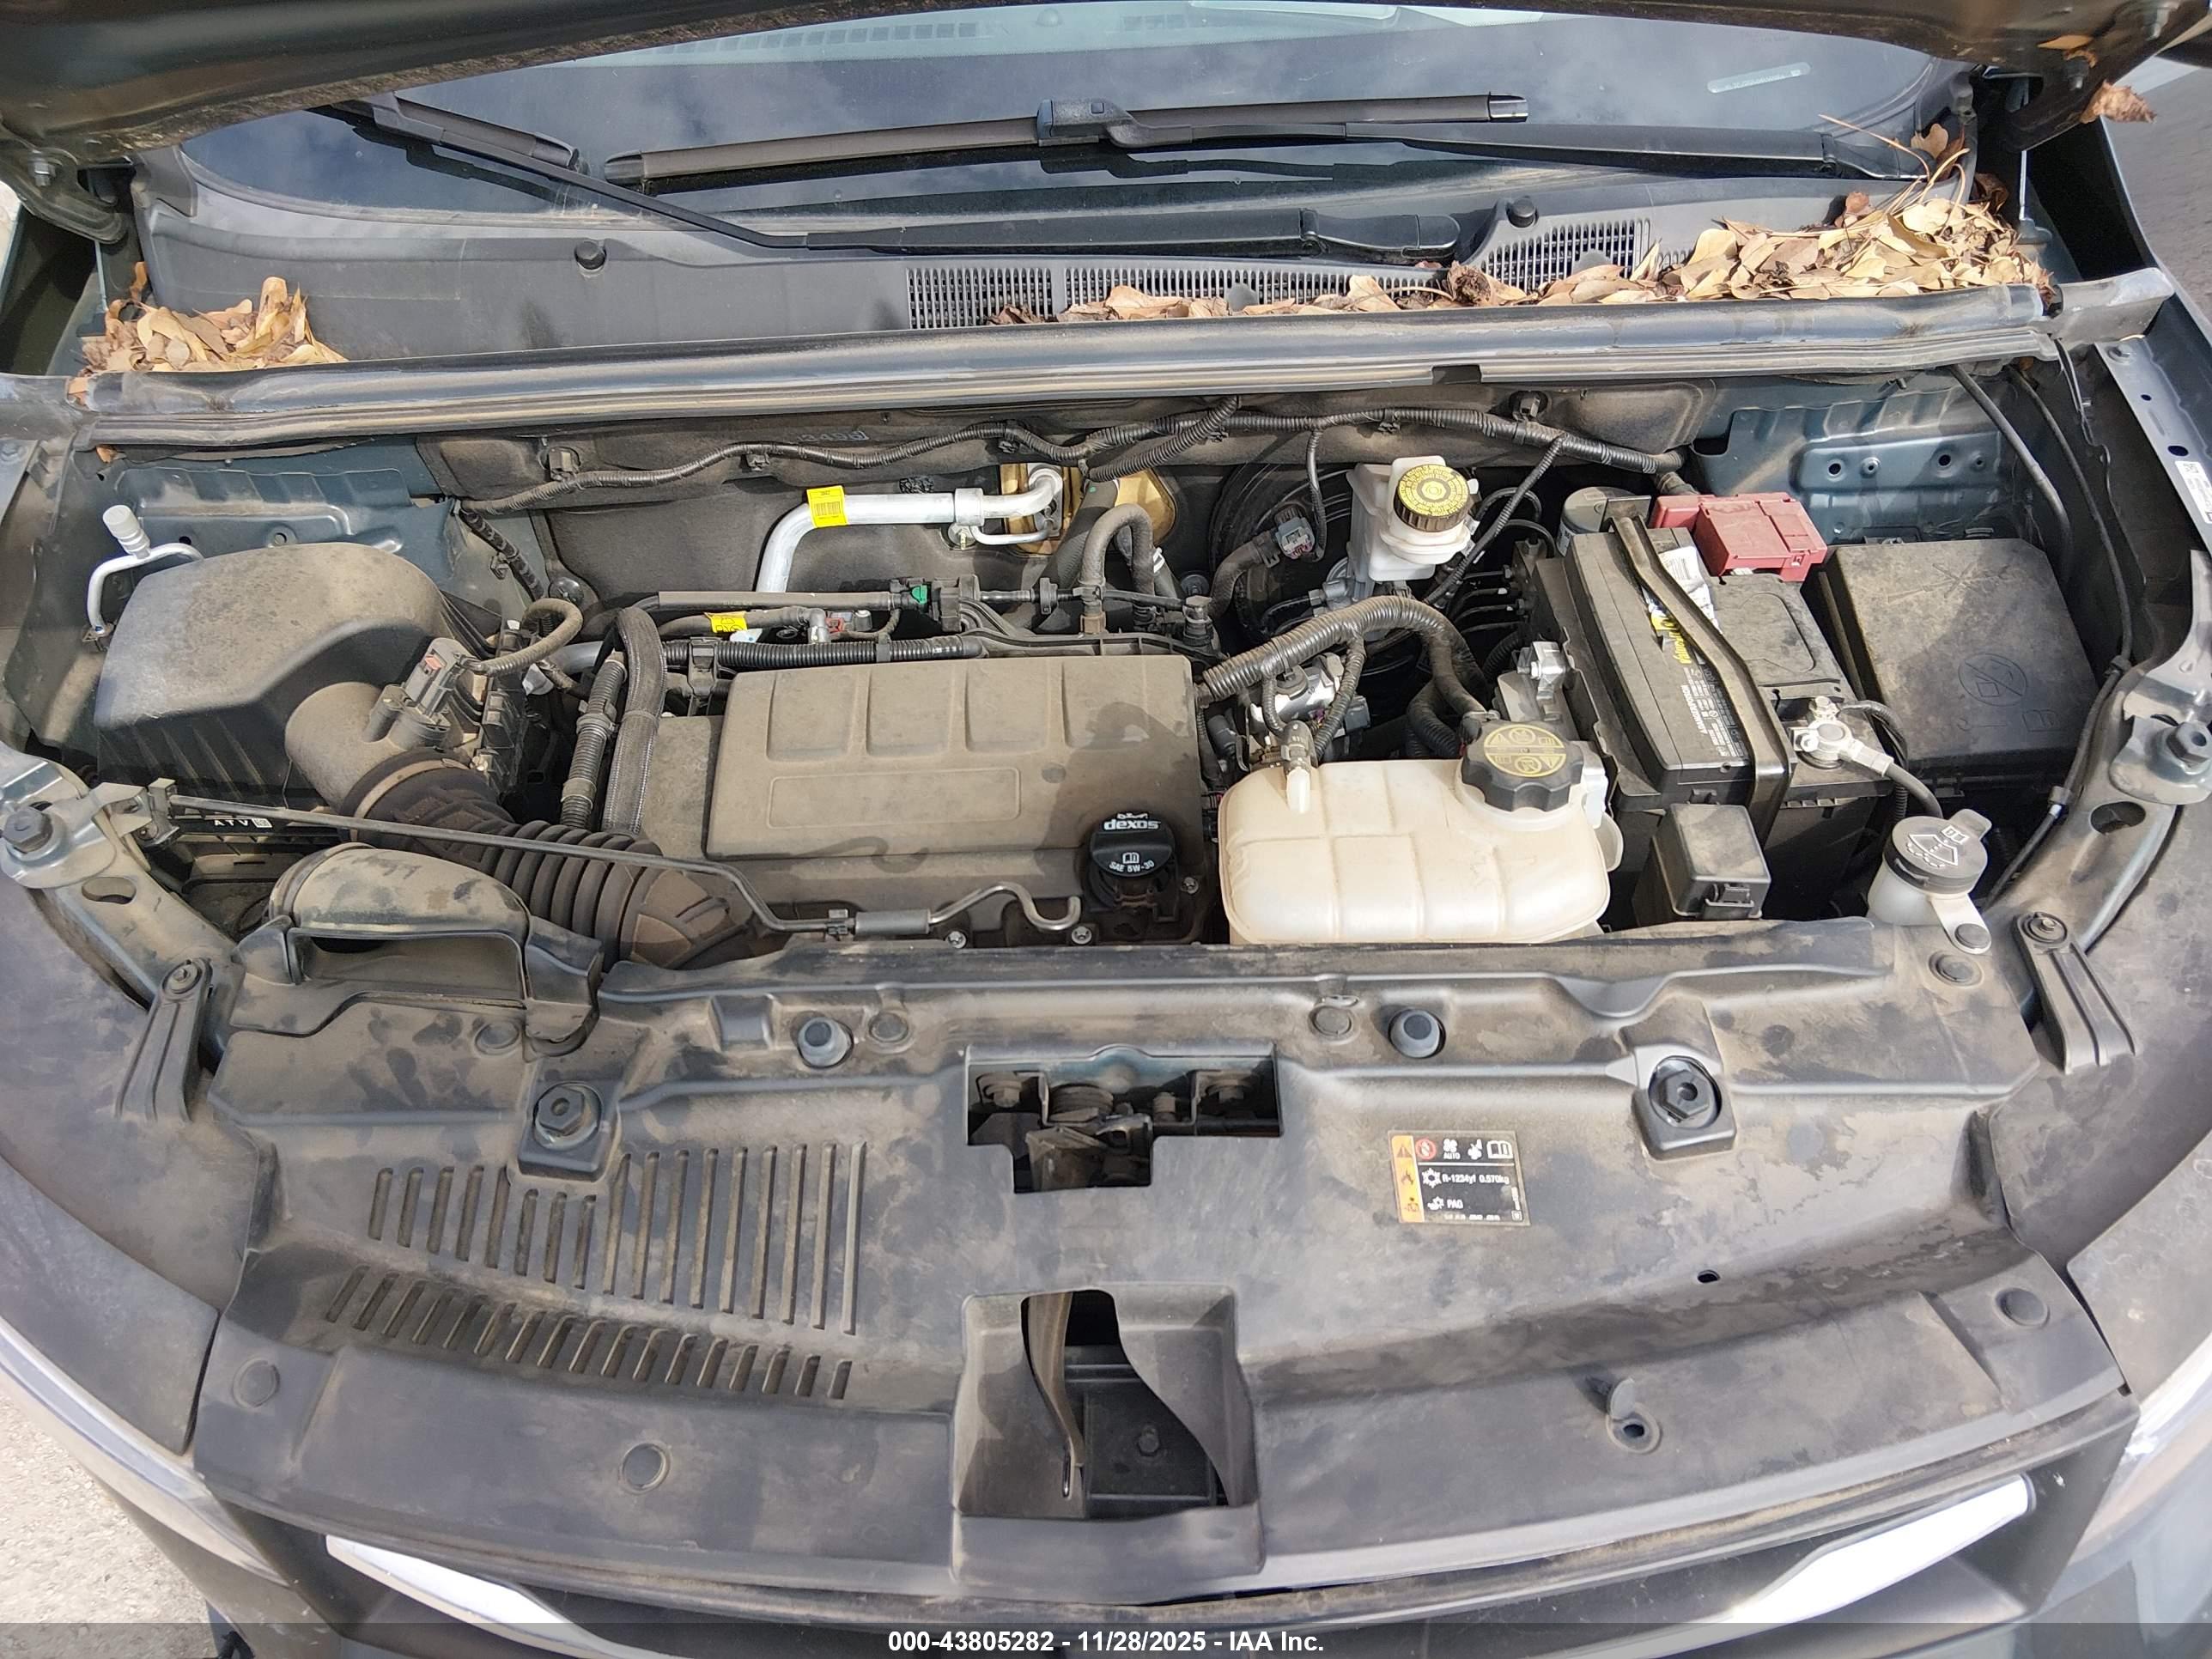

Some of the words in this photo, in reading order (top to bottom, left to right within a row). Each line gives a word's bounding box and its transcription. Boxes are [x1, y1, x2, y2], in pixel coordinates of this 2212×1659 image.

[1104, 819, 1159, 830] dexos
[1109, 861, 1124, 872] SAE
[1127, 860, 1154, 872] 5W-30
